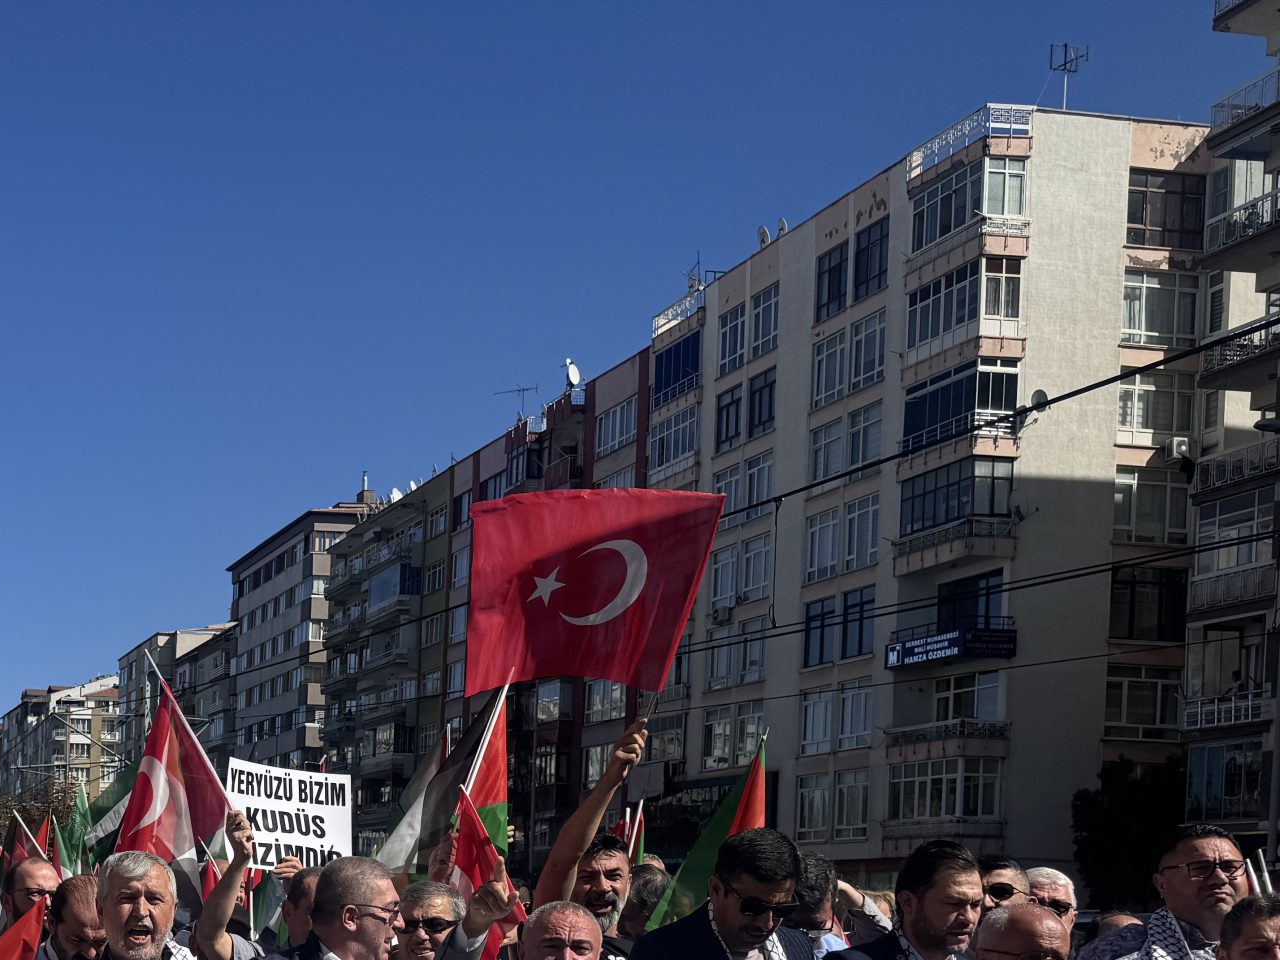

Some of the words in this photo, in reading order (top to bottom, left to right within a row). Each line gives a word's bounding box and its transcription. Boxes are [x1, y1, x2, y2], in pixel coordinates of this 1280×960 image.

[904, 653, 927, 664] HAMZA
[928, 645, 959, 660] ÖZDEMİR
[230, 767, 293, 802] YERYÜZÜ
[298, 775, 346, 807] BİZİM
[245, 806, 326, 839] KUDÜS
